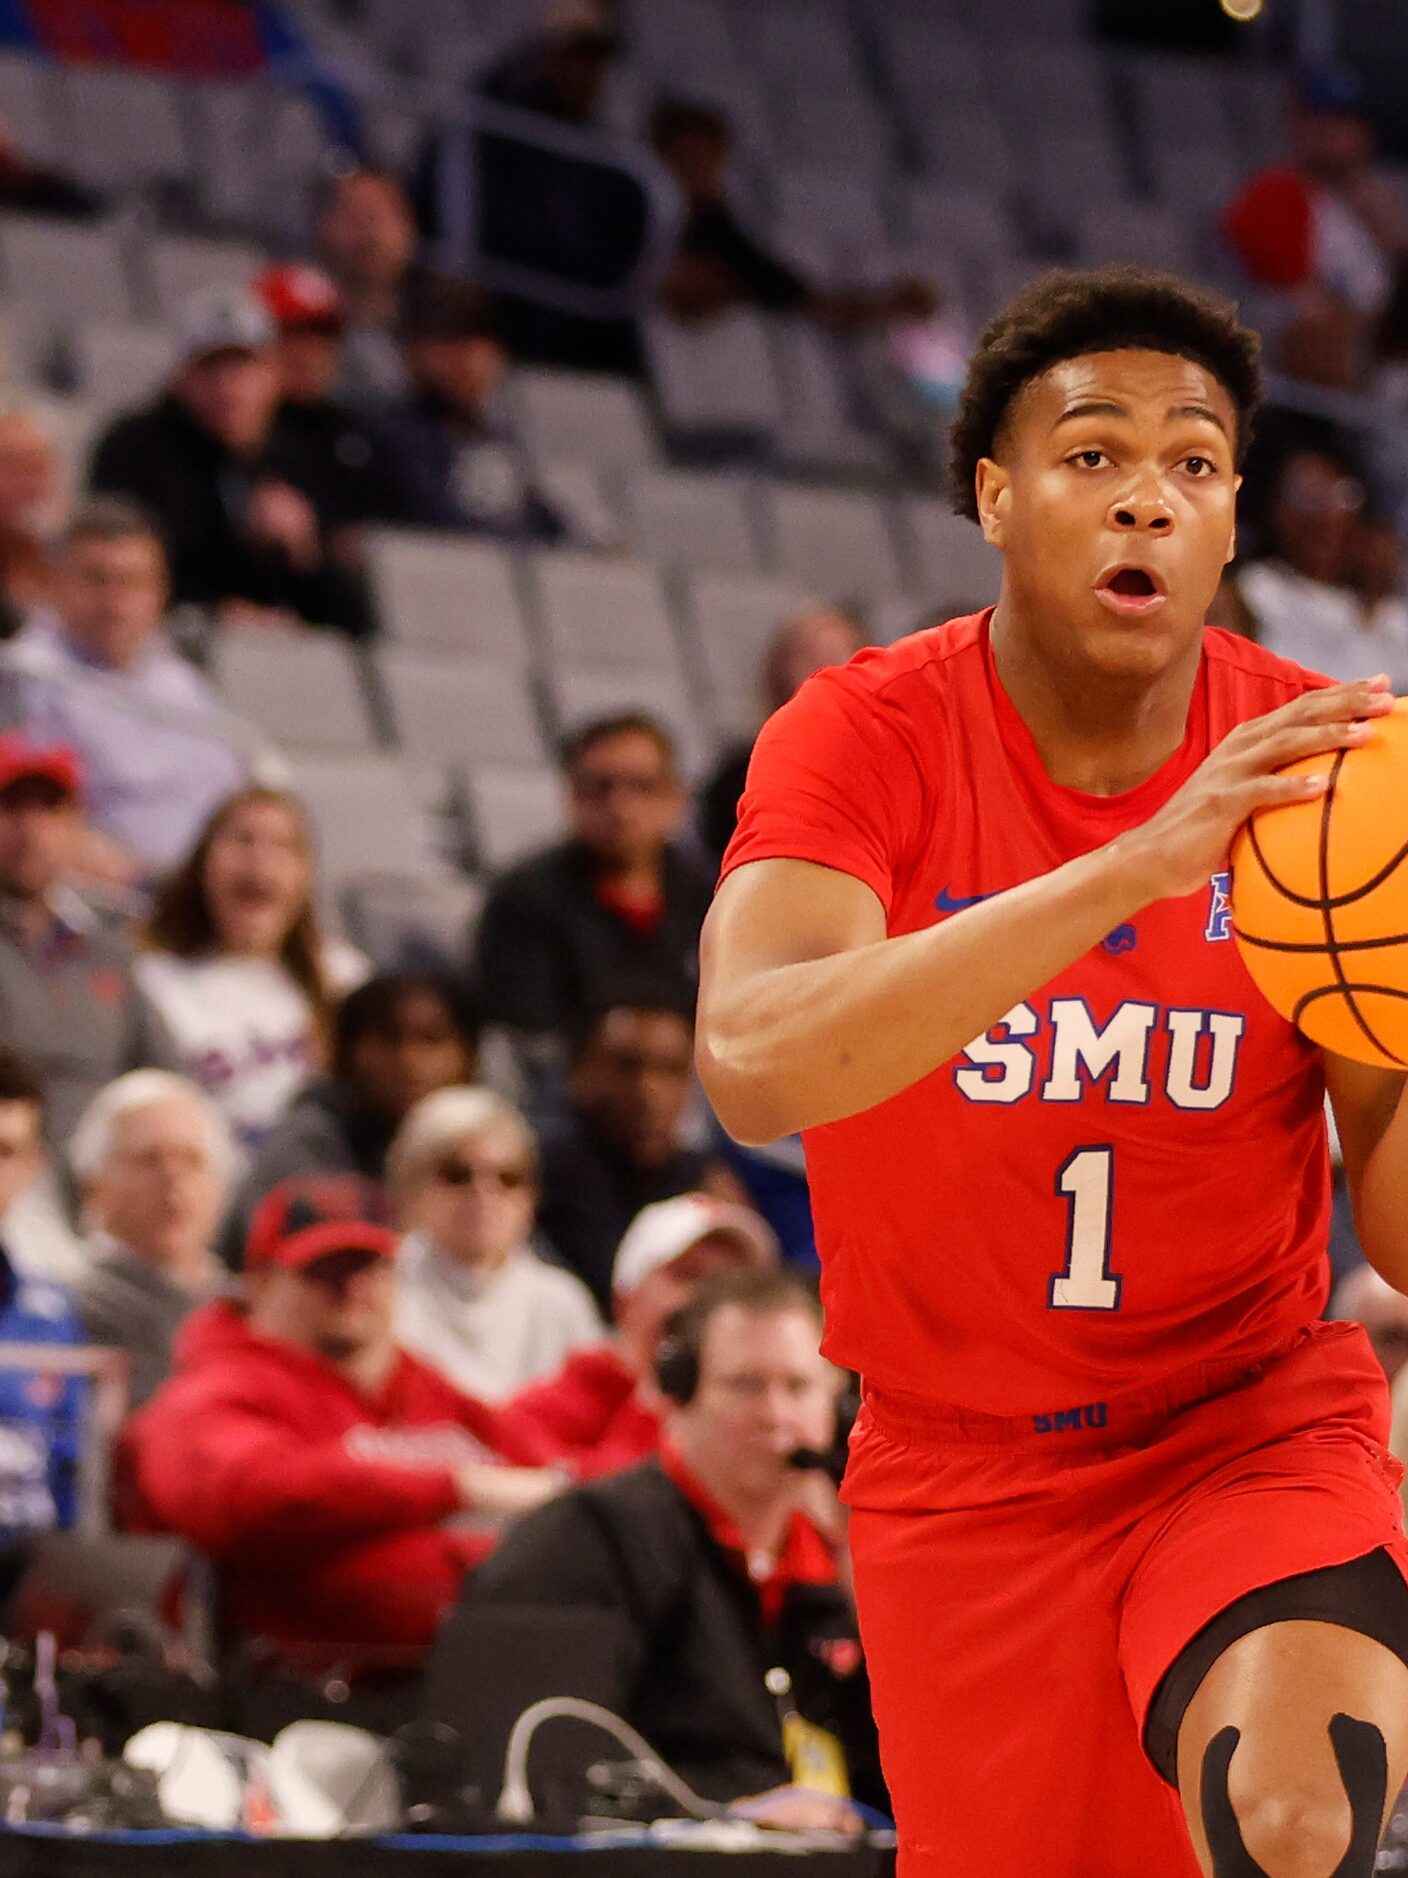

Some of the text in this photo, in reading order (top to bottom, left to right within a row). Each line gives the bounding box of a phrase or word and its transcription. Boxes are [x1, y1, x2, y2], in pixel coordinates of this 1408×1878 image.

[953, 997, 1245, 1111] SMU
[1047, 1144, 1122, 1311] 1
[1032, 1402, 1108, 1434] SMU
